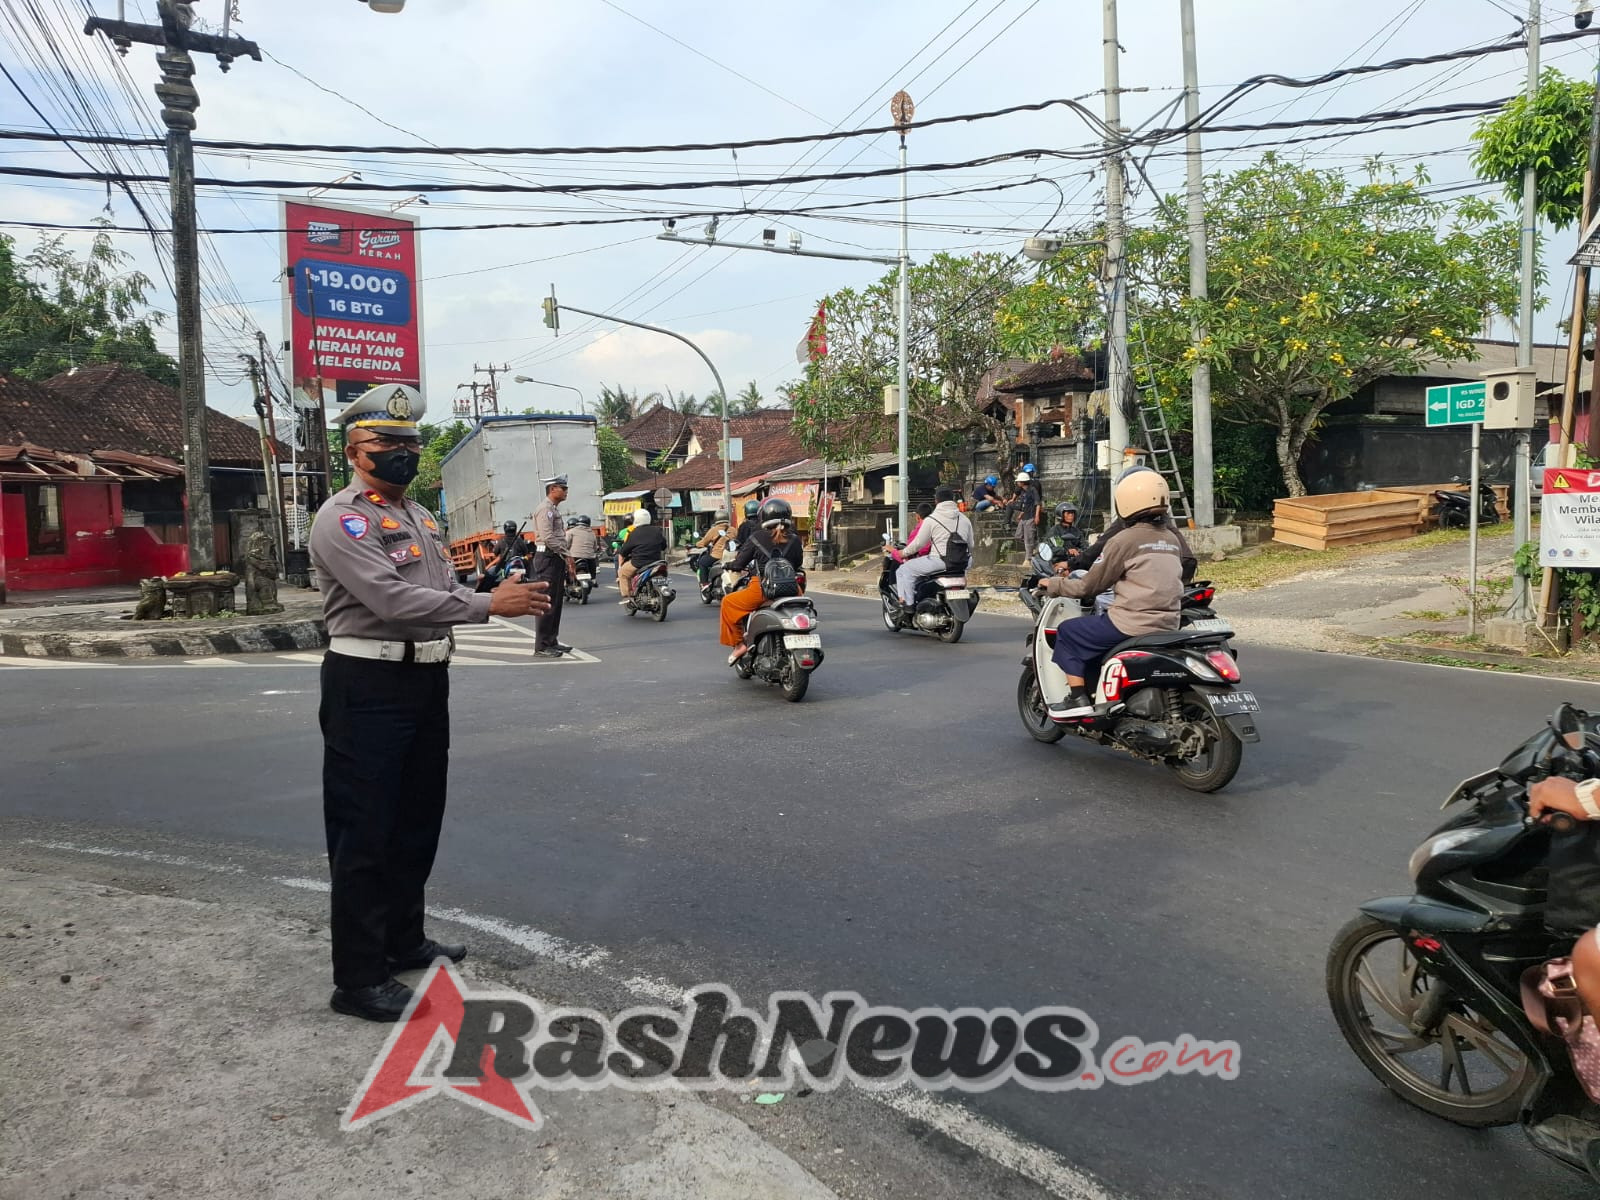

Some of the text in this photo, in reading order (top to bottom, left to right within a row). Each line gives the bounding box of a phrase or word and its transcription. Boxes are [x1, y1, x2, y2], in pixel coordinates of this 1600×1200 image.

[359, 248, 401, 260] MERAH
[328, 299, 384, 316] 16 BTG
[315, 325, 397, 343] NYALAKAN
[308, 339, 405, 358] MERAH YANG
[312, 355, 402, 372] MELEGENDA
[1456, 399, 1476, 410] IGD
